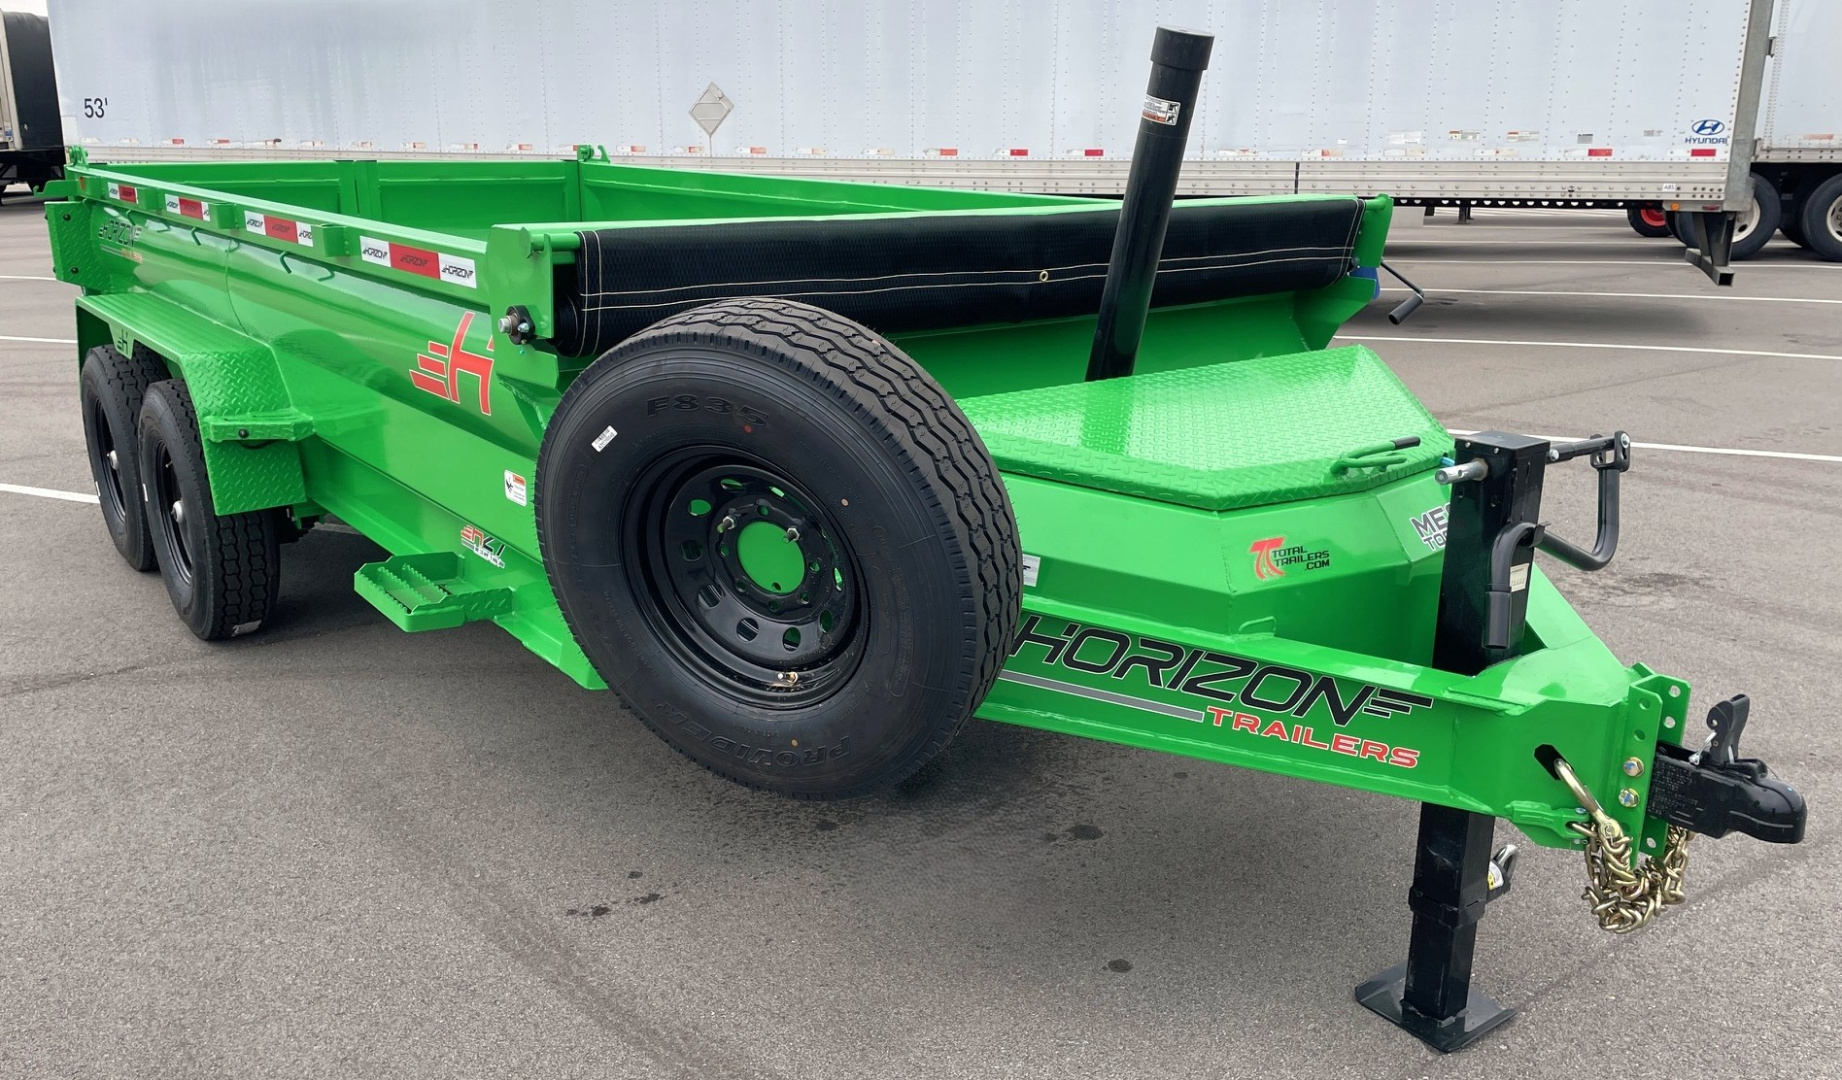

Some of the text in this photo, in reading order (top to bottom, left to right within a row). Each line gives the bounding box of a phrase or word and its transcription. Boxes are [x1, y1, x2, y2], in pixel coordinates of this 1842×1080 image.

[84, 97, 108, 118] 53'
[441, 263, 474, 280] HORIZON
[647, 393, 769, 426] F835
[1272, 545, 1308, 558] TOTAL
[1274, 550, 1330, 567] TRAILERS
[1008, 614, 1378, 727] HORIZON
[655, 701, 850, 767] PROVIDER
[1206, 705, 1421, 769] TRAILERS
